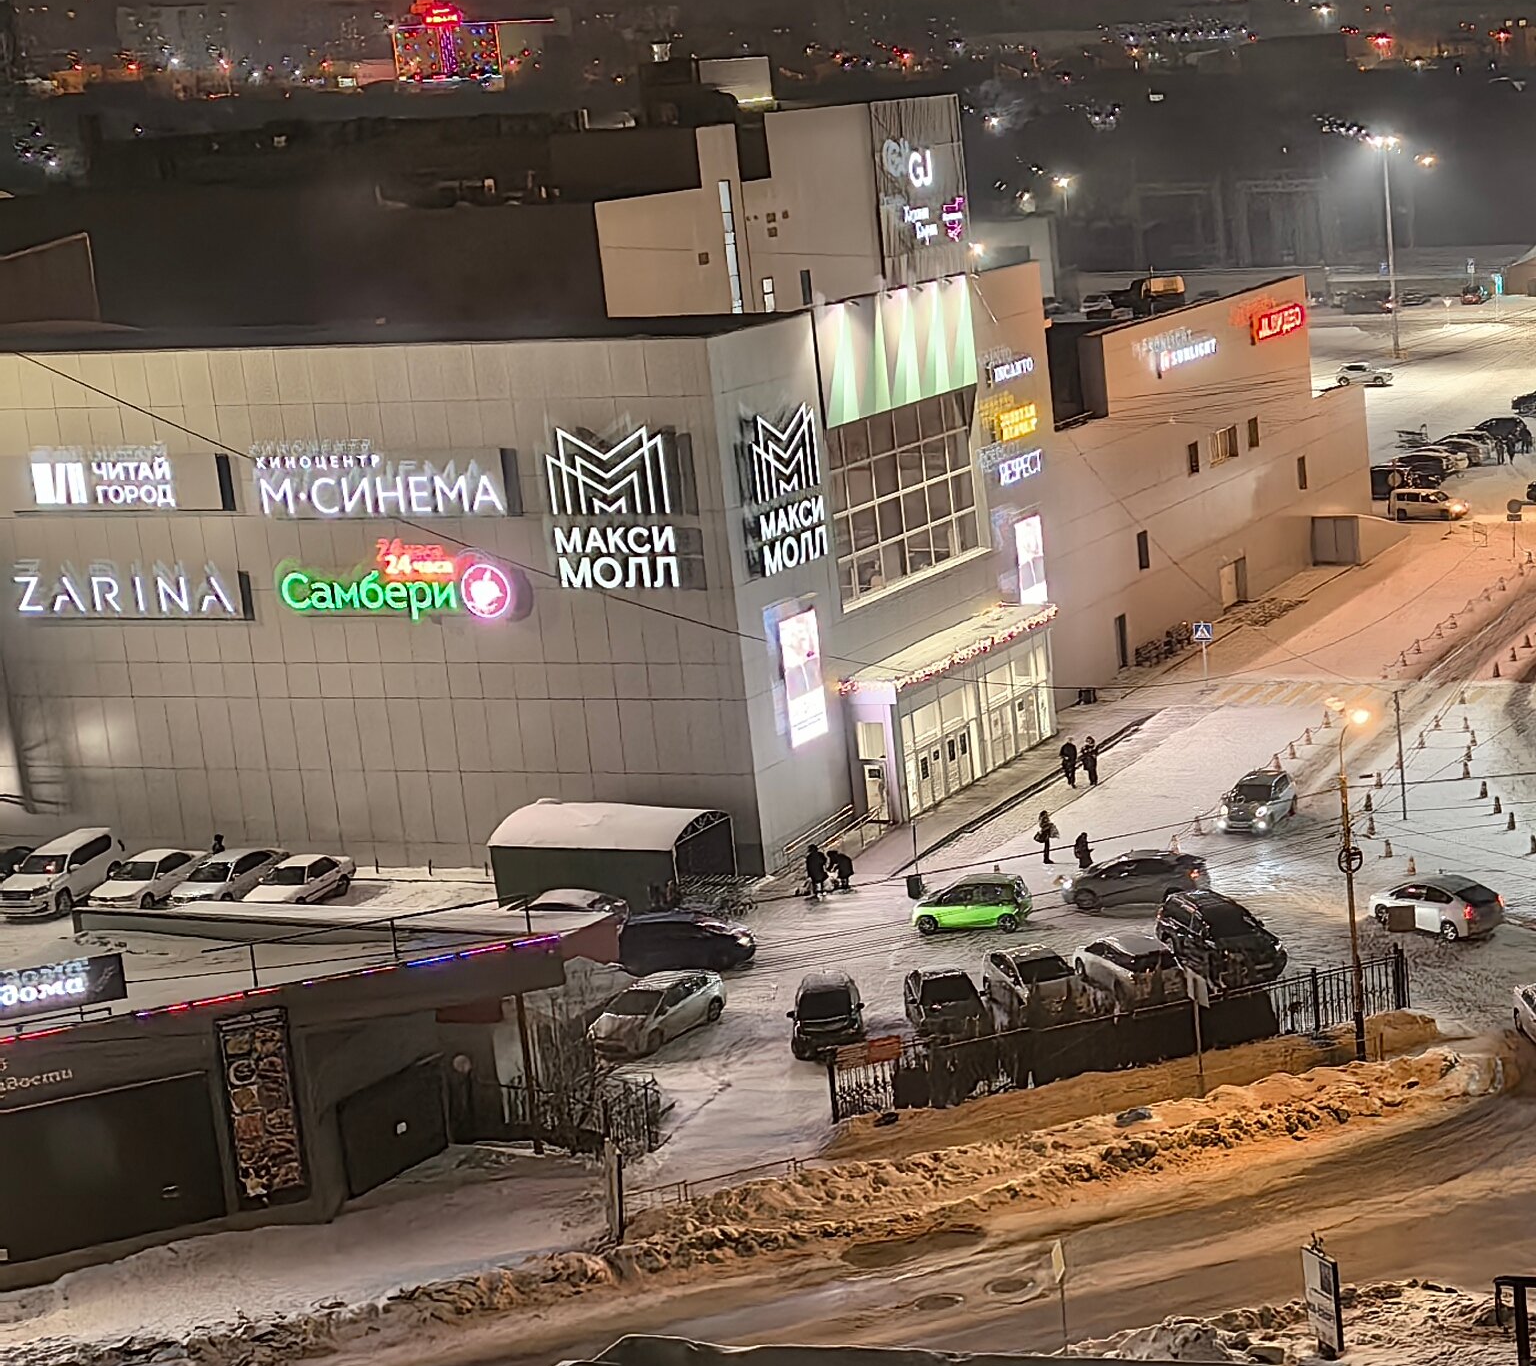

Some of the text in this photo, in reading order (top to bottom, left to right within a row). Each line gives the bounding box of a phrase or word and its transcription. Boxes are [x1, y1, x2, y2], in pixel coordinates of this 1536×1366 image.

[909, 149, 933, 188] GJ
[994, 357, 1033, 382] INCANTO
[92, 456, 171, 481] ЧИТАЙ
[256, 455, 381, 470] КИНОЦЕНТР
[1000, 449, 1042, 486] RESPECT
[96, 485, 176, 507] ГОРОД
[760, 496, 825, 542] МАКСИ
[554, 526, 676, 554] МАКСИ
[763, 525, 828, 577] МОЛЛ
[385, 555, 411, 574] 24
[558, 556, 680, 588] МОЛЛ
[13, 577, 235, 612] ZARINA
[281, 571, 458, 620] Самбери
